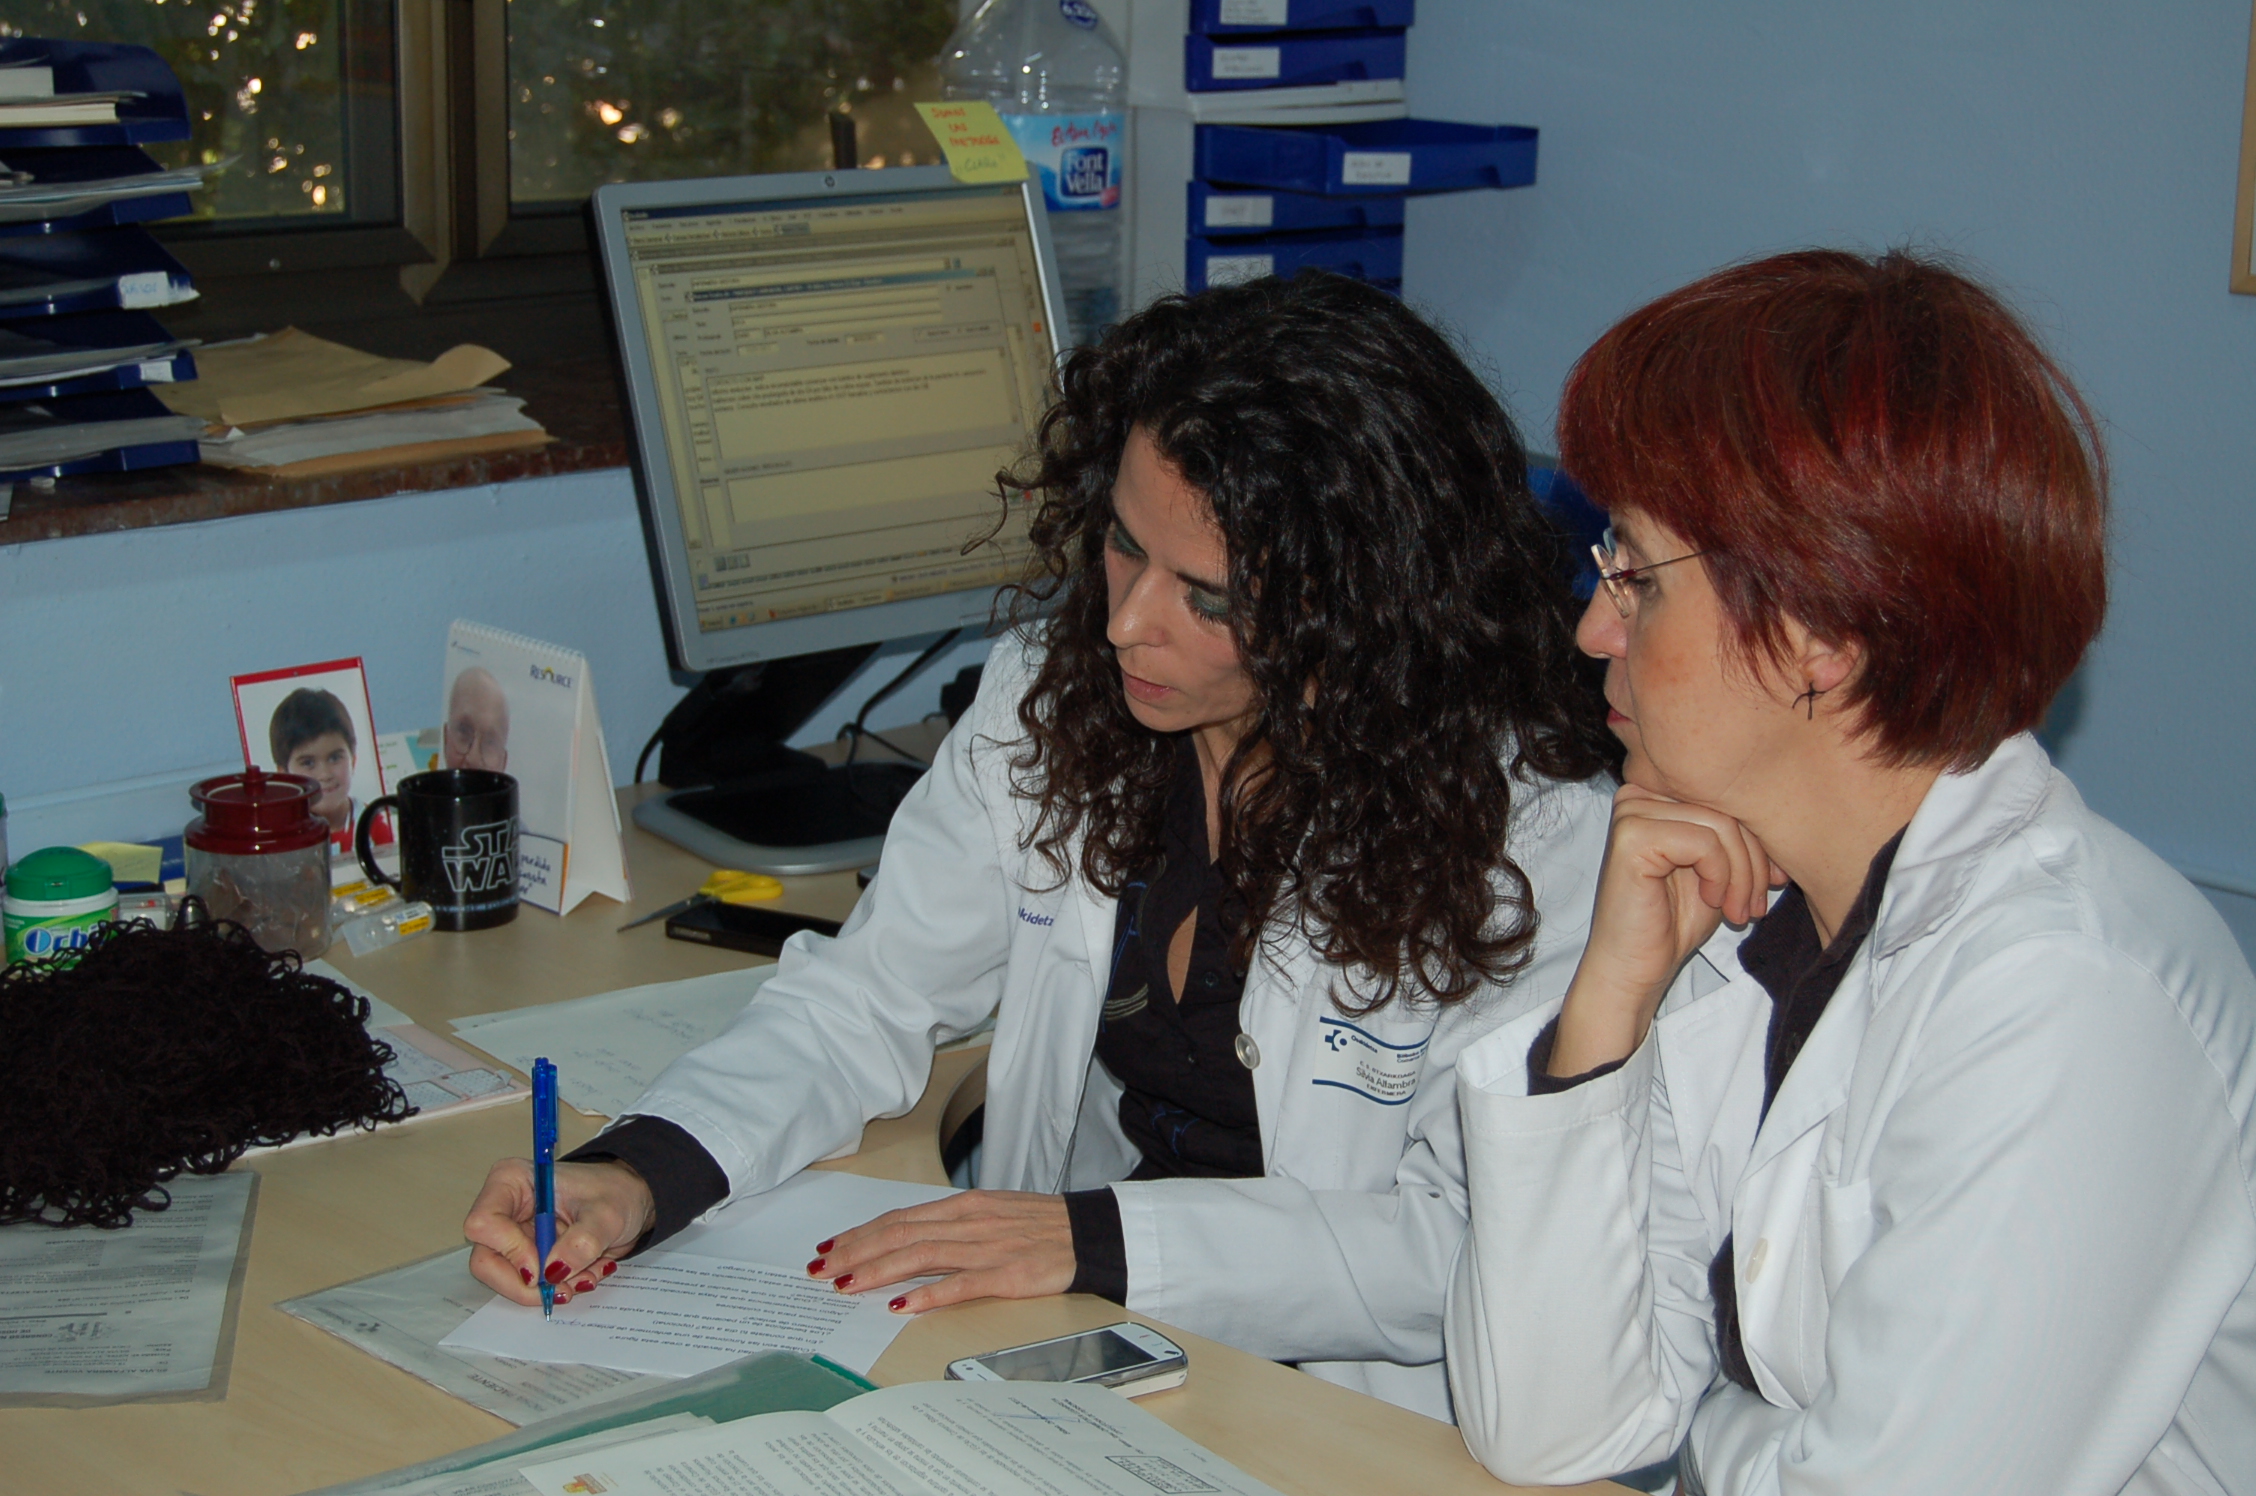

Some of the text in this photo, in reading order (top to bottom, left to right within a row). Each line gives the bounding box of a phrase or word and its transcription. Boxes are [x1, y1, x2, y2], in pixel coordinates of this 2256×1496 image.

[1066, 152, 1103, 171] Font
[1065, 173, 1103, 194] Vella
[1356, 1066, 1417, 1090] Silvia Alfambra
